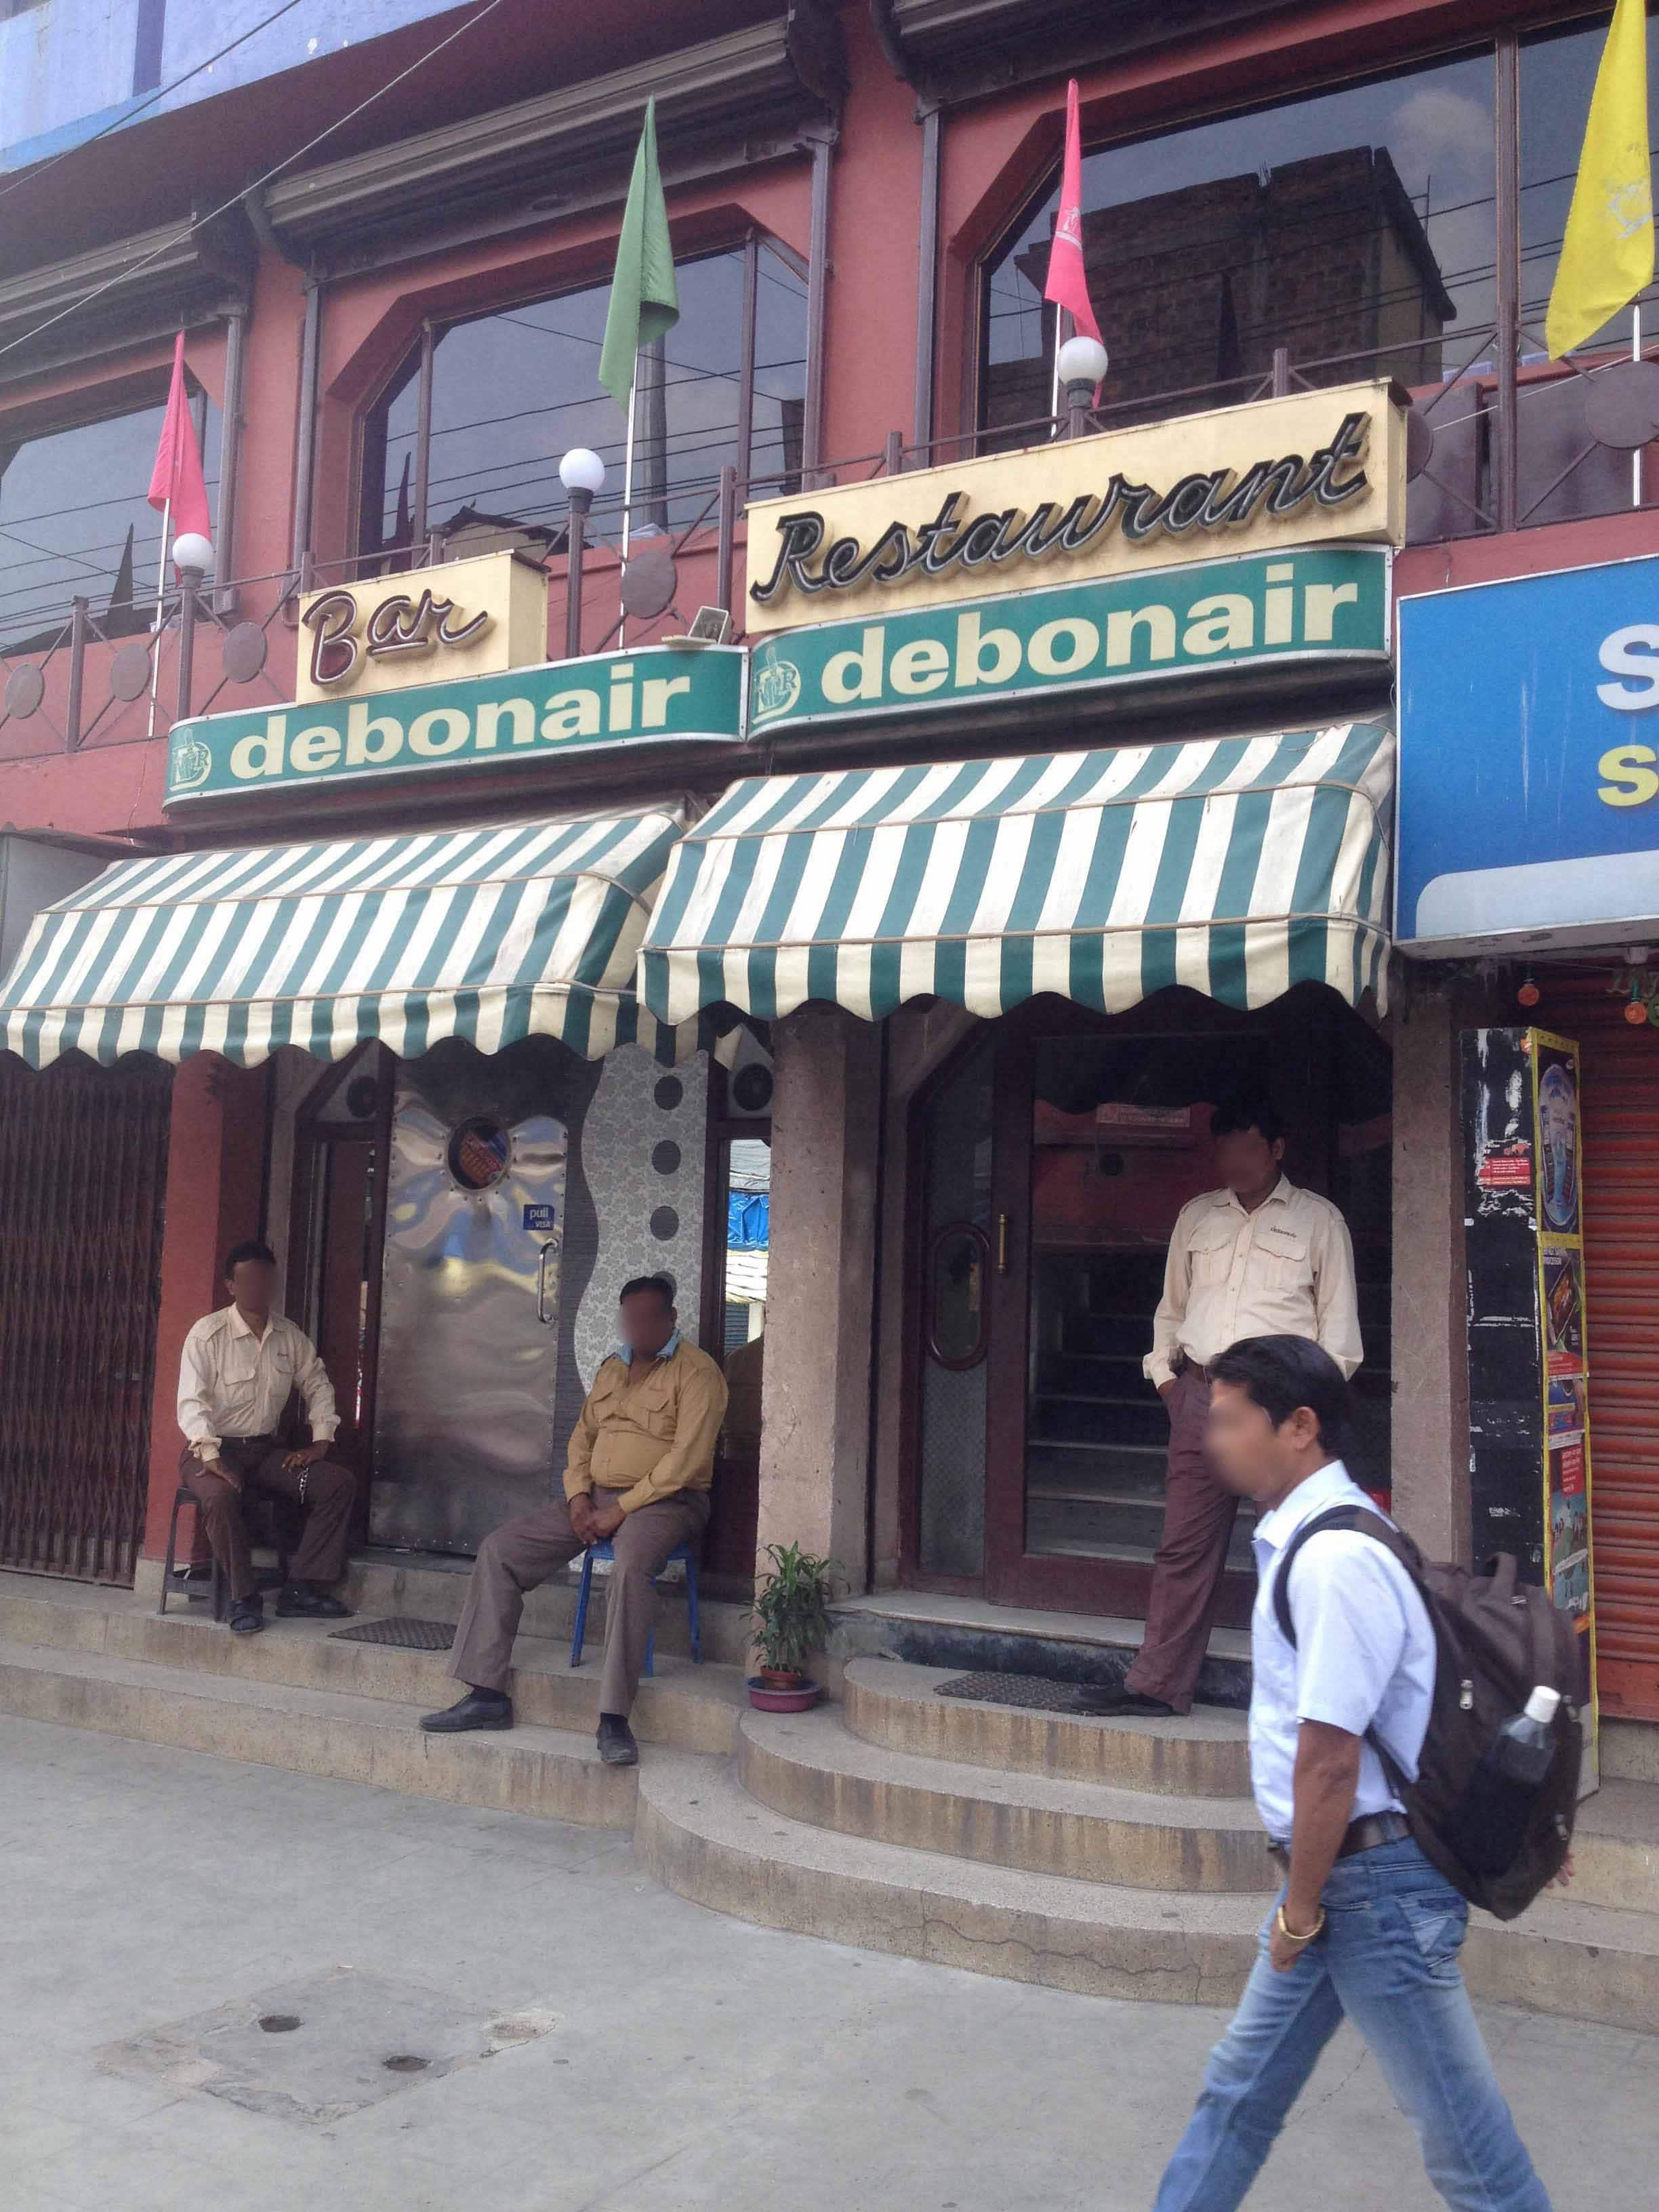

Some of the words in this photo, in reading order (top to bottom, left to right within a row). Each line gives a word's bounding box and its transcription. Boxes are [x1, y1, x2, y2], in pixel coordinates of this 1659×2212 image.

[750, 411, 1371, 603] Restaurant
[302, 588, 489, 686] Bar
[821, 562, 1358, 705] debonair
[230, 663, 691, 780] debonair
[530, 1207, 548, 1220] pull
